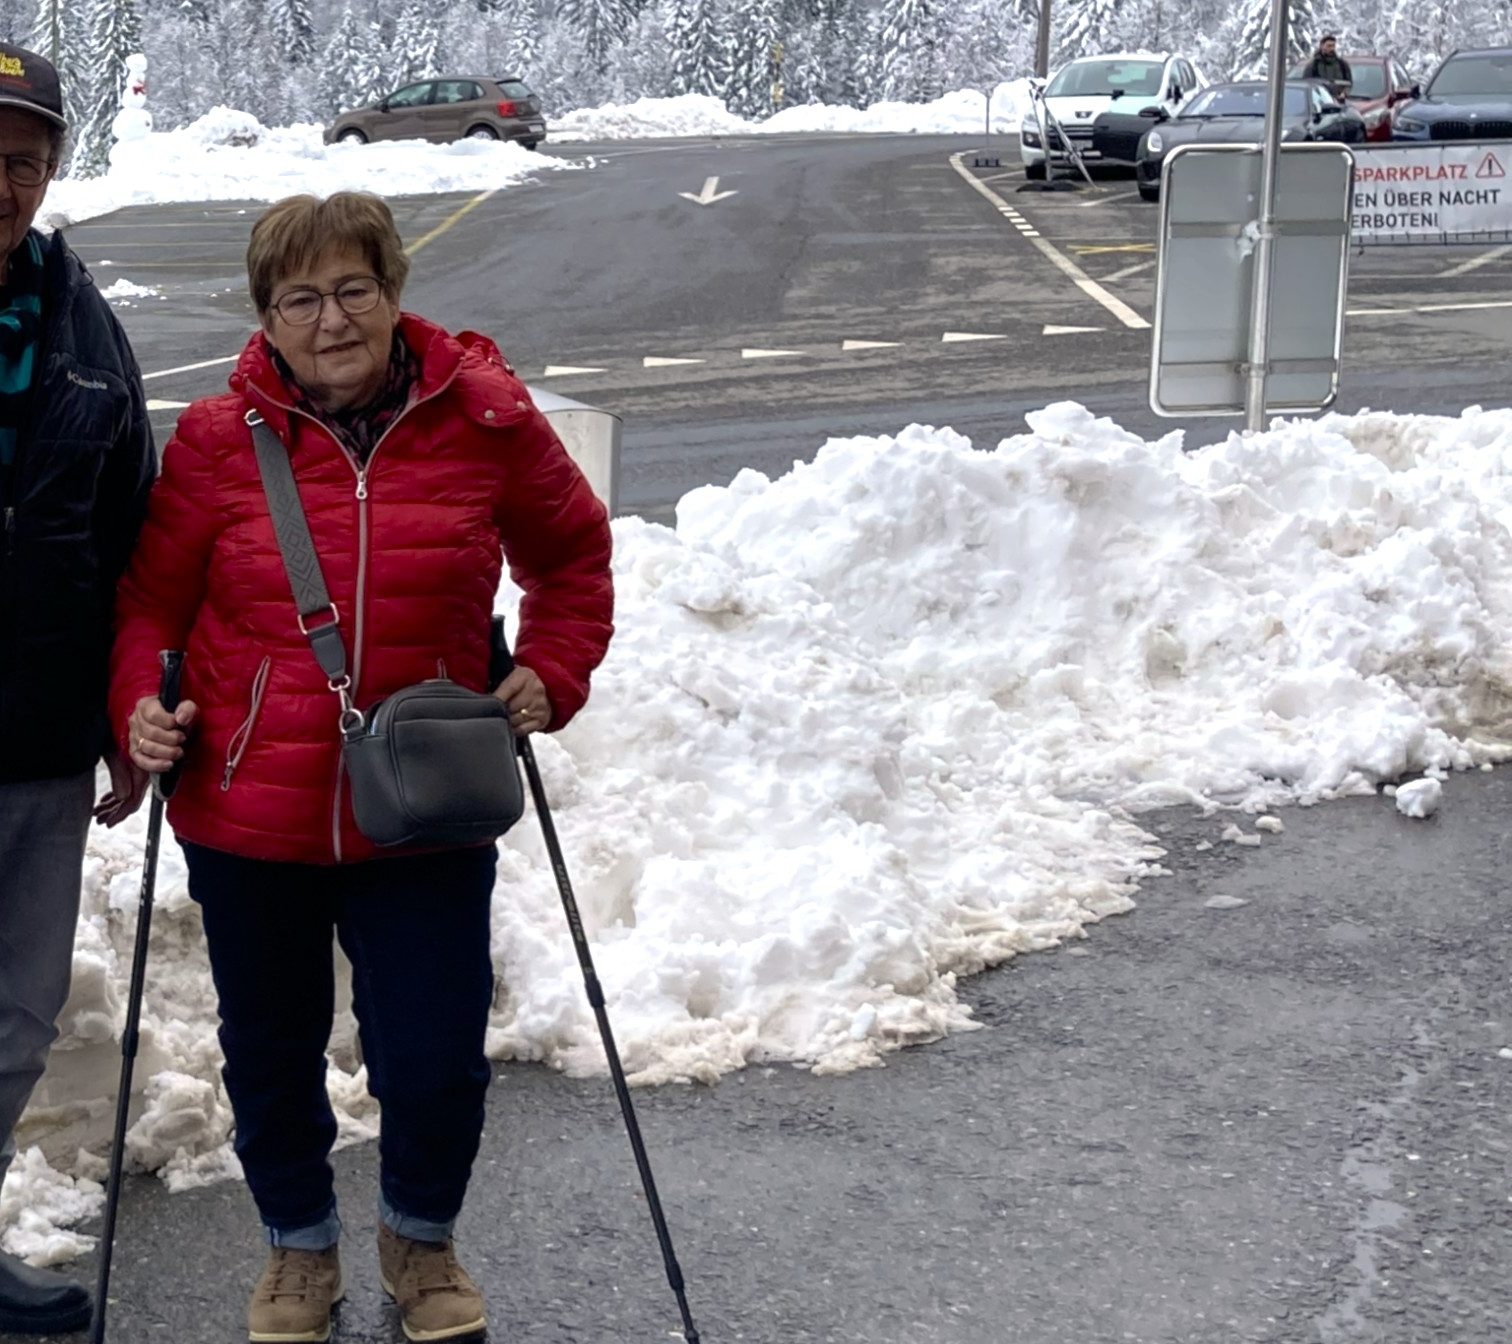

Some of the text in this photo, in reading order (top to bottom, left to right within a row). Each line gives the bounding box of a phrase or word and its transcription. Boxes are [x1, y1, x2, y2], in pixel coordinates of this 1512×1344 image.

[1353, 164, 1468, 183] SPARKPLATZ
[1354, 188, 1501, 208] EN ÜBER NACHT
[1351, 212, 1439, 229] ERBOTEN!
[72, 372, 108, 390] Columbia
